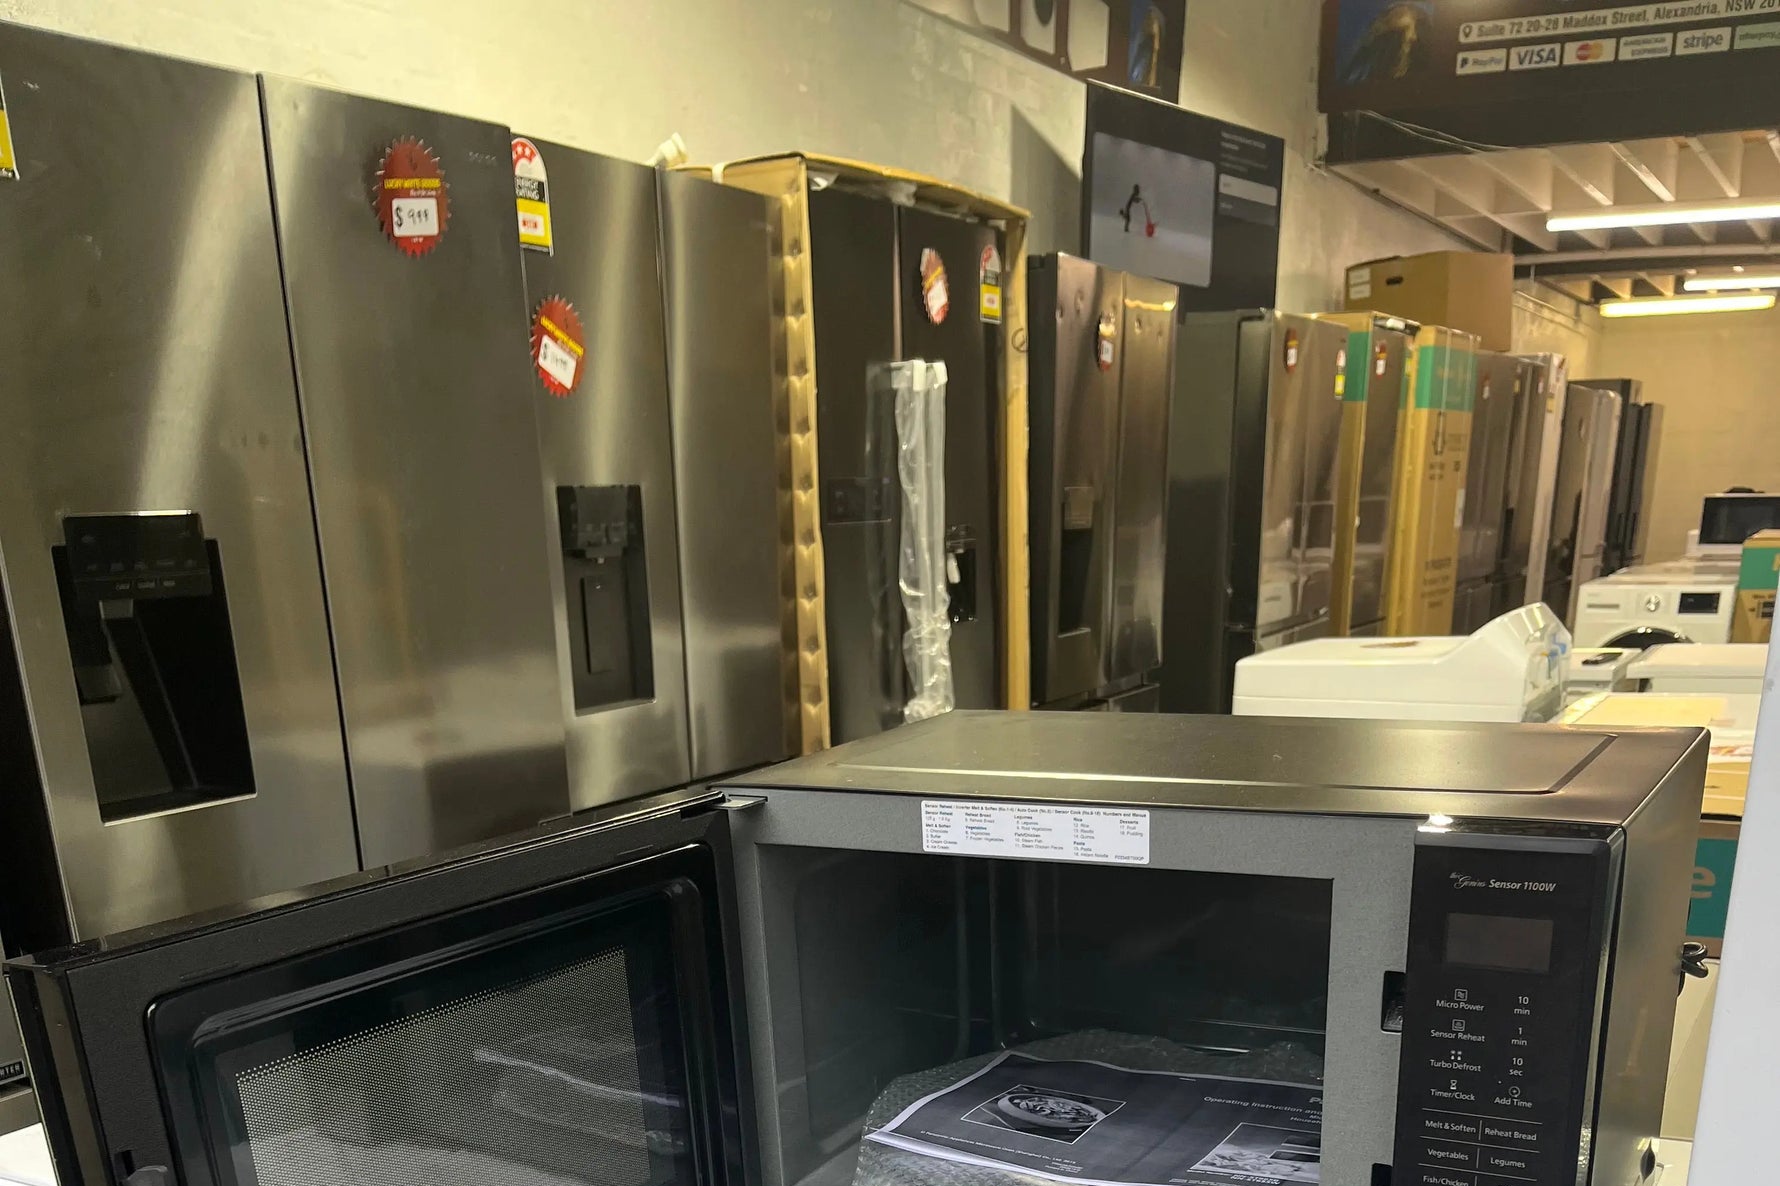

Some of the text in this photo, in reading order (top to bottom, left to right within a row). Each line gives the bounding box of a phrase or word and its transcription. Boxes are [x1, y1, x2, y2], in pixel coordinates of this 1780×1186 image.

[1477, 24, 1505, 37] Suite
[1509, 21, 1523, 34] 72
[1526, 18, 1560, 32] 20-28
[1562, 12, 1607, 28] Maddox
[1725, 0, 1756, 12] NSW
[1683, 33, 1724, 50] stripe
[1517, 47, 1556, 65] VISA
[1489, 879, 1522, 890] Sensor
[1524, 881, 1556, 892] 1100W
[1436, 1000, 1485, 1012] Micro Power
[1518, 996, 1529, 1005] 10
[1514, 1007, 1531, 1015] min
[1430, 1029, 1485, 1042] Sensor Reheat
[1518, 1027, 1522, 1035] 1
[1511, 1038, 1528, 1046] min
[1430, 1059, 1482, 1072] Turbo Defrost
[1512, 1057, 1524, 1066] 10
[1509, 1069, 1523, 1077] sec
[1430, 1088, 1476, 1101] Timer/Clock
[1203, 1096, 1250, 1107] Operating
[1251, 1102, 1303, 1113] Instruction
[1494, 1096, 1533, 1108] Add Time
[1425, 1120, 1477, 1133] Melt & Soften
[1484, 1127, 1537, 1141] Reheat Bread
[1427, 1148, 1469, 1161] Vegetables
[1490, 1157, 1526, 1168] Legumes
